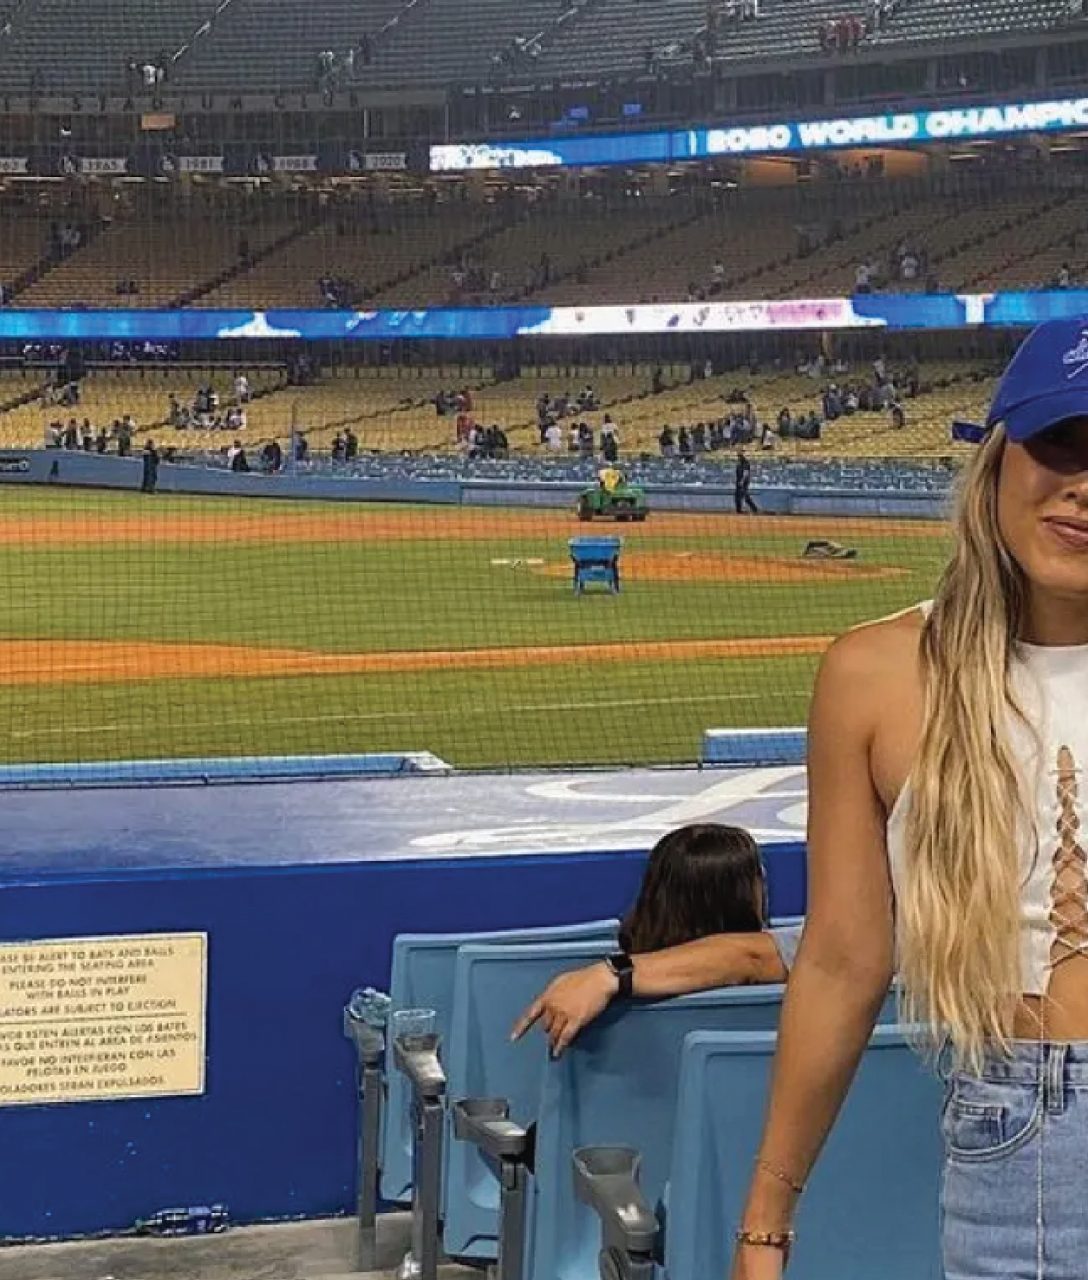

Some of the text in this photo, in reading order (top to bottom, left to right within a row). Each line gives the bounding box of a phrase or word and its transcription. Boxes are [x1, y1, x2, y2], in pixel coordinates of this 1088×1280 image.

[799, 114, 919, 146] WORLD
[72, 951, 85, 960] TO
[118, 948, 141, 958] AND
[58, 963, 76, 972] THE
[9, 979, 45, 990] PLEASE
[50, 978, 67, 988] DO
[69, 977, 92, 987] NOT
[26, 990, 54, 1000] WITH
[105, 986, 131, 997] PLAY
[63, 1003, 106, 1014] SUBJECT
[110, 1002, 124, 1012] TO
[127, 999, 176, 1012] EJECTION
[38, 1055, 58, 1065] NO
[129, 1050, 154, 1060] CON
[157, 1048, 177, 1059] LAS
[91, 1063, 127, 1074] JUEGO
